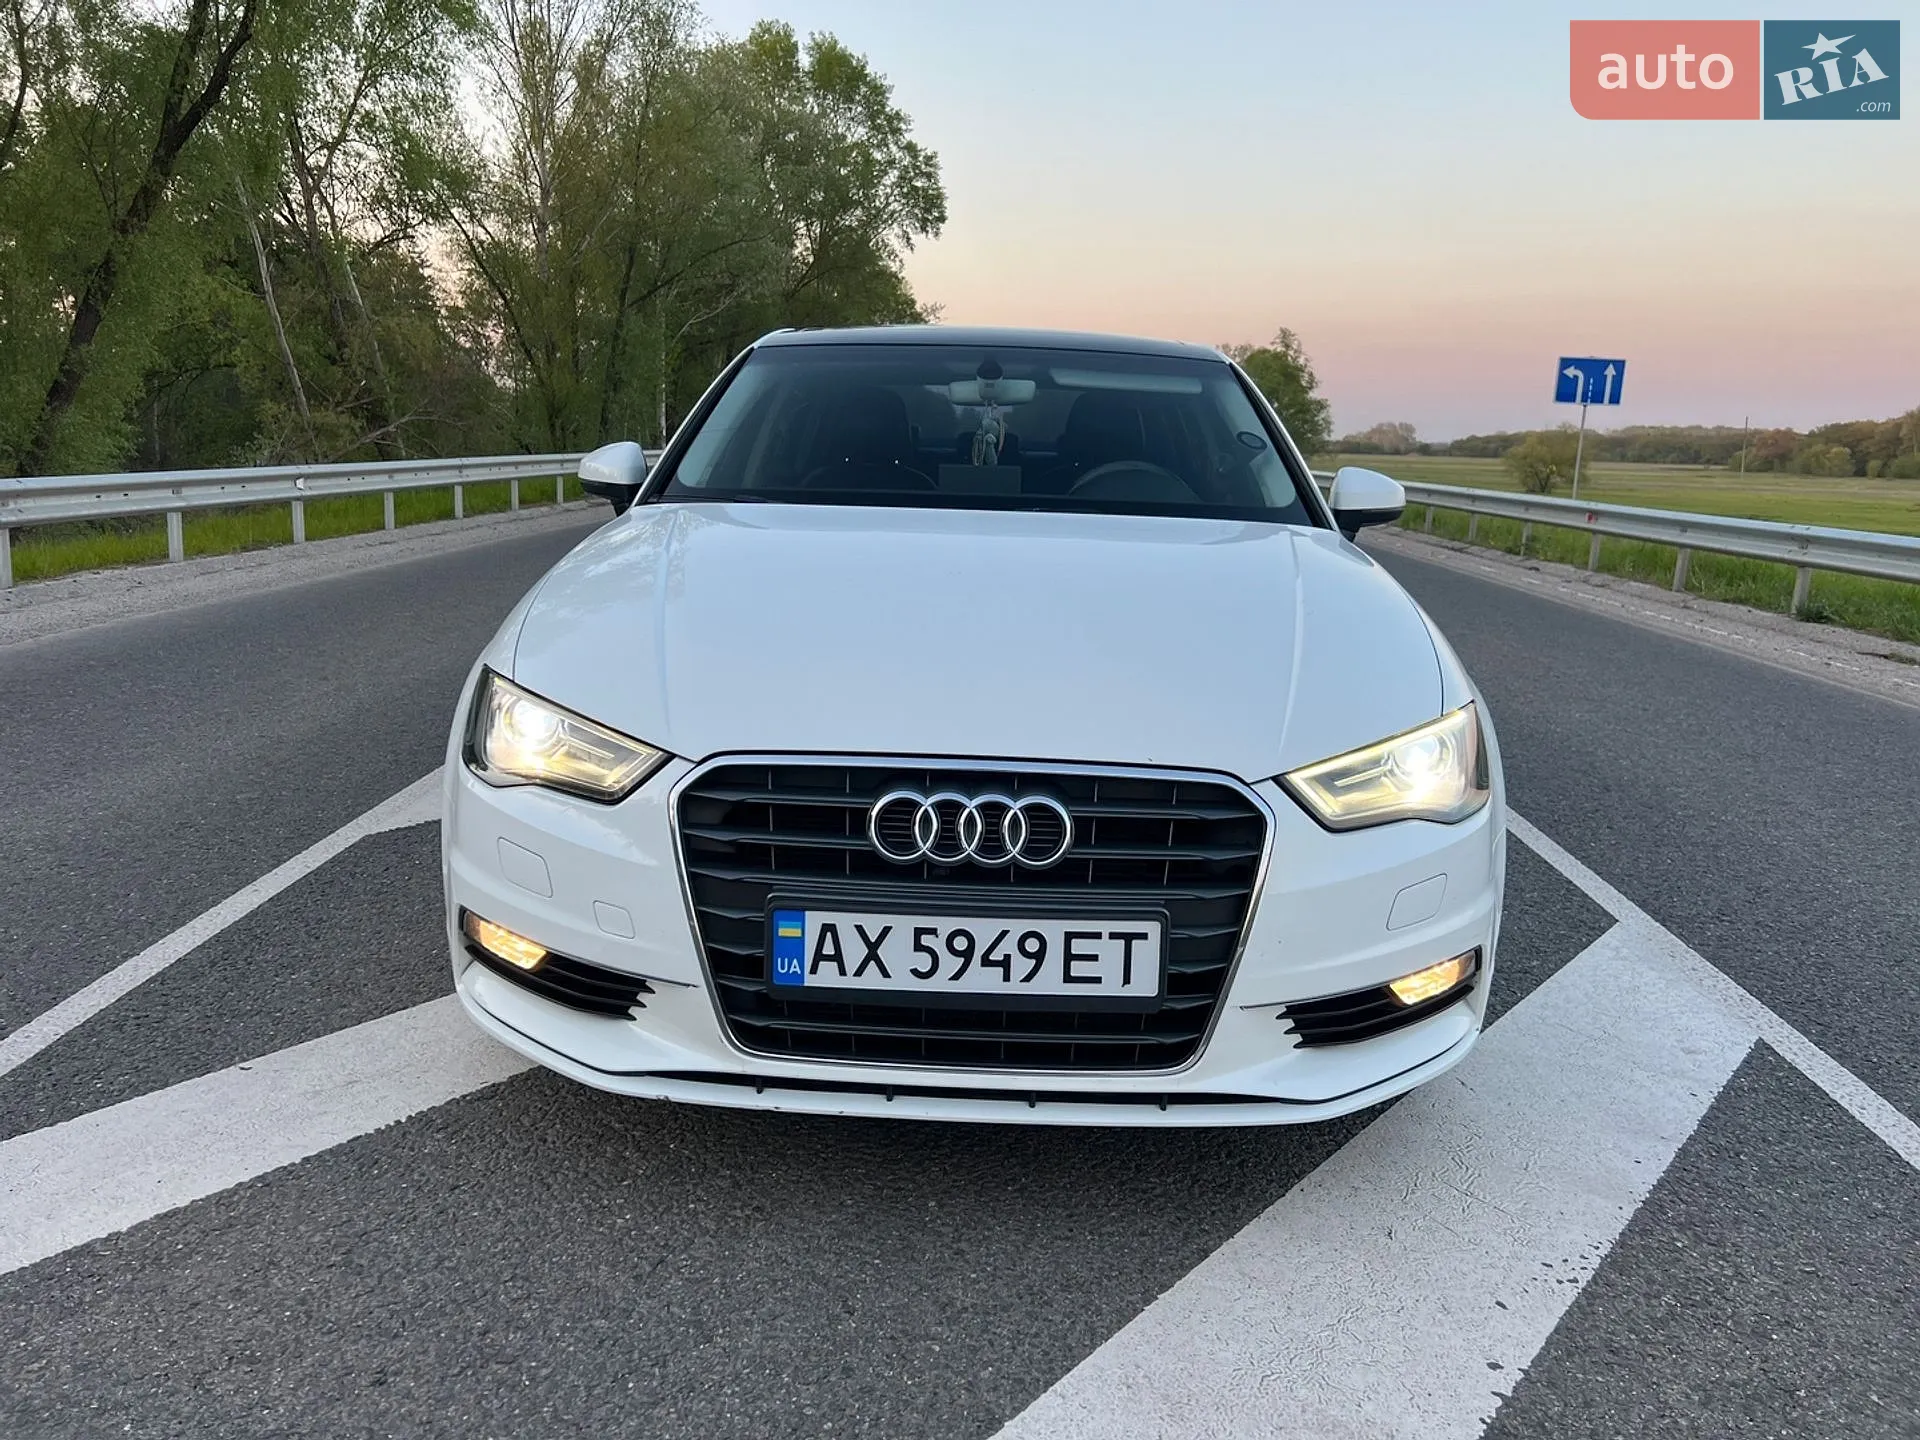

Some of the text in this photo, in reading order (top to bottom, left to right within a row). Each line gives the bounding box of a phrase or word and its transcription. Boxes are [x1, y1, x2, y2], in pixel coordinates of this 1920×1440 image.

[777, 957, 801, 975] UA
[809, 923, 1149, 987] AX 5949 ET
